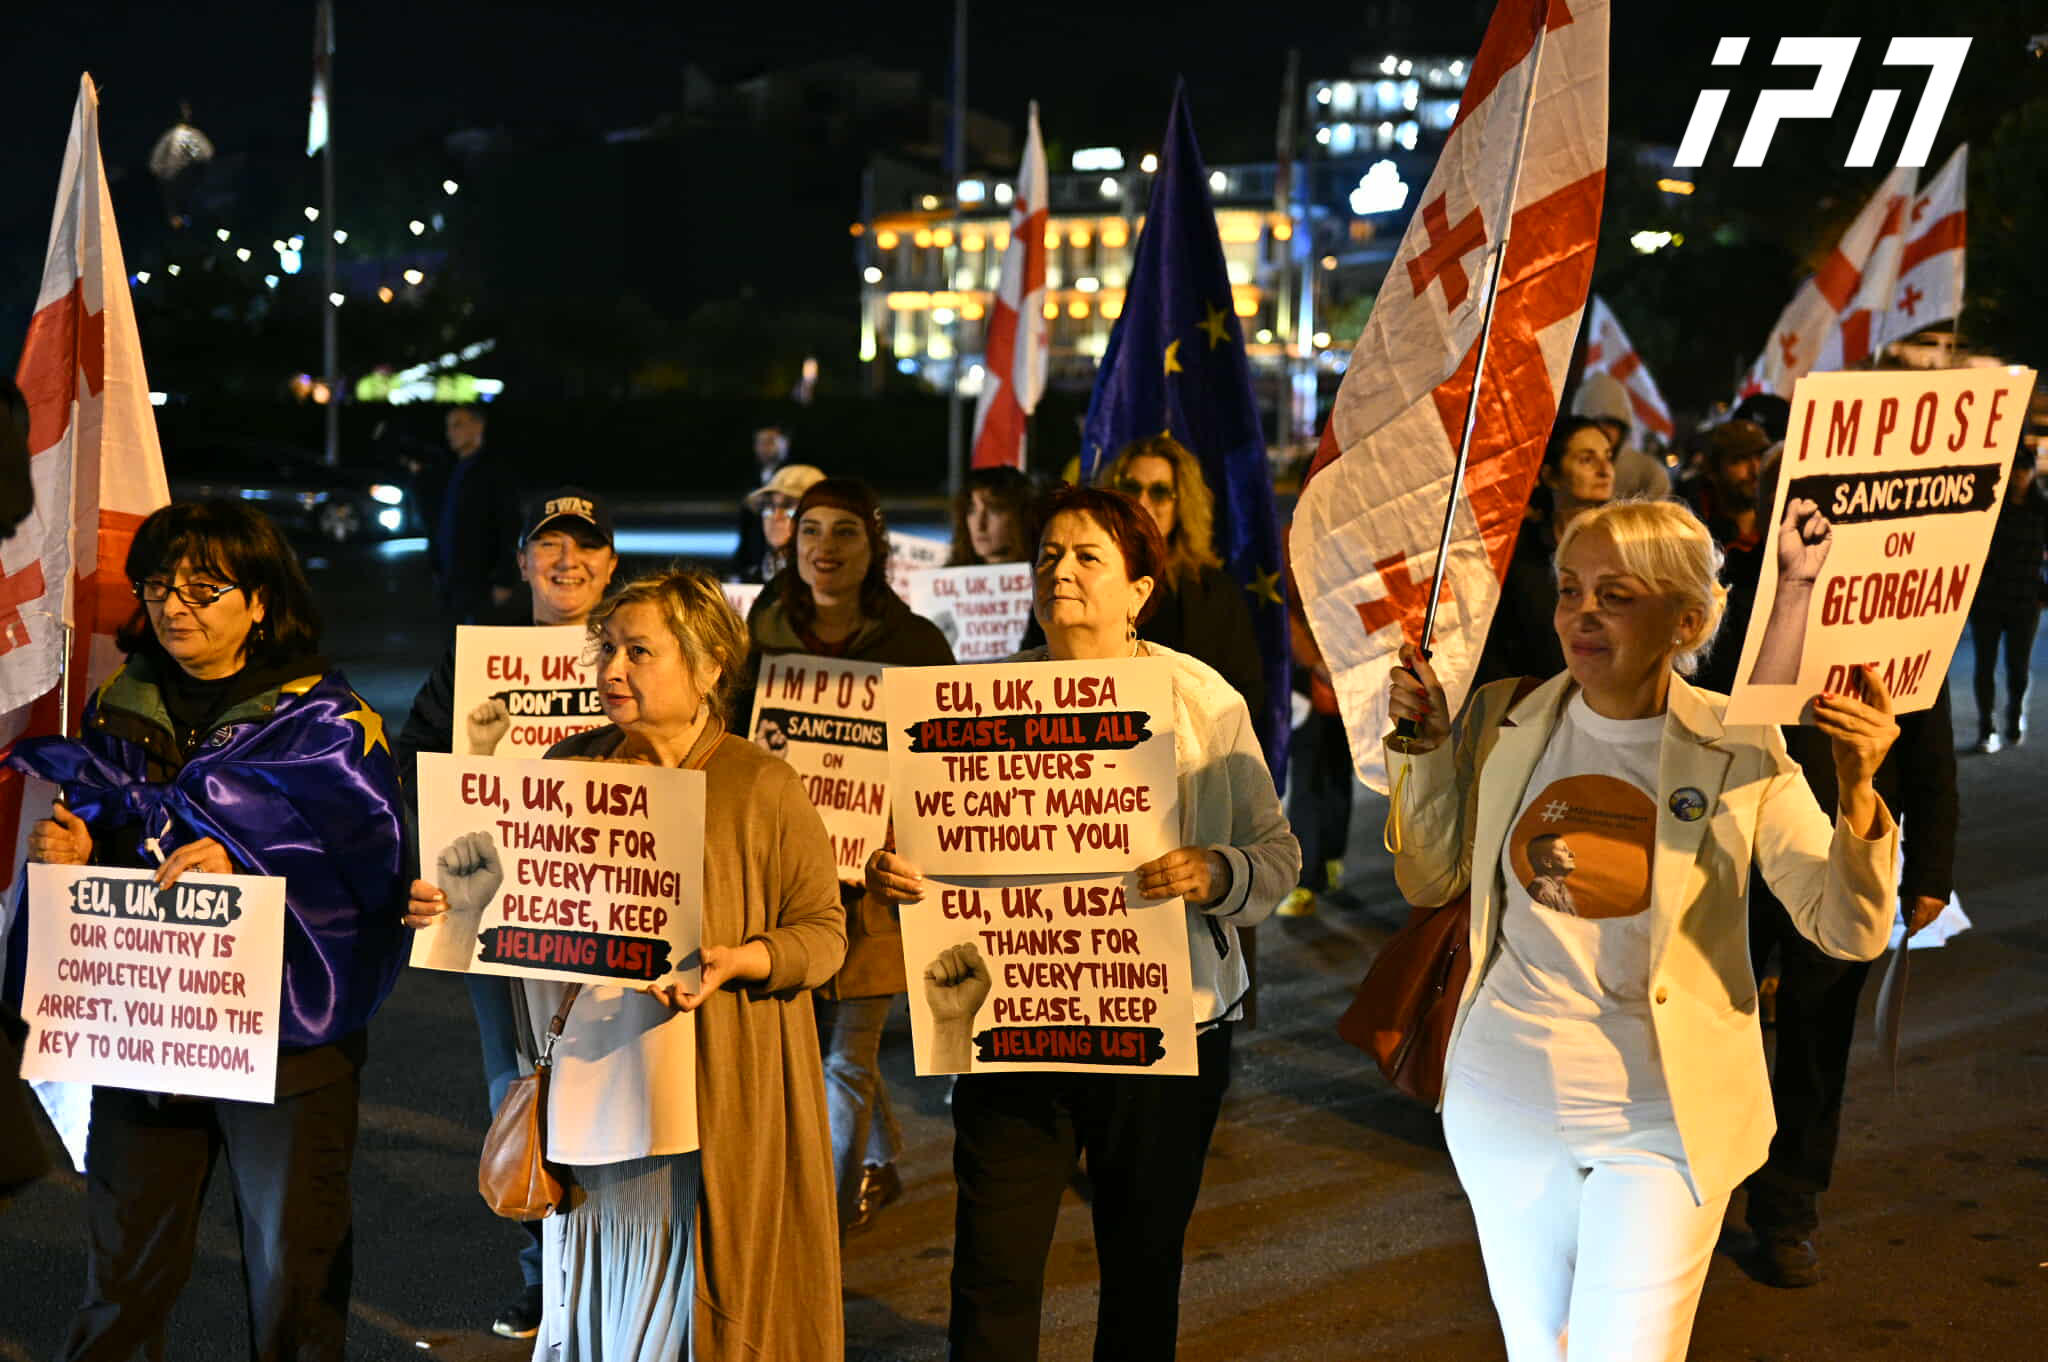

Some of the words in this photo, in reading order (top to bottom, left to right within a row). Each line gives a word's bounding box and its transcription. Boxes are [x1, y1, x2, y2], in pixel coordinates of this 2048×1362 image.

[1799, 389, 2009, 462] IMPOSE
[1831, 473, 1976, 515] SANCTIONS
[1884, 531, 1915, 558] ON
[1821, 564, 1970, 627] GEORGIAN
[487, 655, 530, 686] EU,
[542, 655, 586, 685] UK,
[765, 664, 879, 712] IMPOS
[1823, 649, 1931, 701] DRAM!
[936, 681, 981, 716] EU,
[993, 678, 1042, 714] UK,
[1054, 676, 1118, 708] USA
[787, 716, 883, 745] SANCTIONS
[920, 720, 1016, 751] PLEASE,
[1025, 716, 1086, 747] PULL
[1095, 715, 1139, 743] ALL
[822, 752, 844, 769] ON
[942, 755, 989, 783] THE
[999, 753, 1094, 781] LEVERS
[461, 773, 510, 814] EU,
[522, 775, 573, 819] UK,
[586, 780, 648, 819] USA
[801, 774, 885, 816] ORGIAN
[914, 790, 955, 818] WE
[1046, 786, 1151, 818] MANAGE
[496, 820, 600, 854] THANKS
[609, 829, 657, 861] FOR
[937, 823, 1058, 855] WITHOUT
[1067, 822, 1130, 855] YOU!
[77, 880, 117, 918] EU,
[125, 883, 166, 923] UK,
[175, 886, 229, 922] USA
[517, 859, 681, 906] EVERYTHING!
[502, 894, 599, 933] PLEASE,
[609, 902, 667, 935] KEEP
[942, 888, 991, 925] EU,
[1001, 887, 1053, 924] UK,
[1063, 886, 1127, 918] USA
[70, 923, 107, 950] OUR
[114, 926, 206, 958] COUNTRY
[212, 933, 236, 958] IS
[495, 929, 597, 966] HELPING
[607, 939, 653, 977] US!
[979, 928, 1081, 956] THANKS
[1091, 928, 1140, 956] FOR
[58, 958, 172, 993] COMPLETELY
[179, 968, 246, 998] UNDER
[1004, 962, 1168, 994] EVERYTHING!
[37, 994, 117, 1023] ARREST.
[125, 1000, 163, 1027] YOU
[171, 1005, 217, 1031] HOLD
[225, 1009, 263, 1035] THE
[993, 996, 1090, 1026] PLEASE,
[1099, 997, 1157, 1023] KEEP
[39, 1030, 79, 1058] KEY
[87, 1034, 110, 1058] TO
[117, 1036, 155, 1065] OUR
[162, 1041, 255, 1075] FREEDOM.
[993, 1031, 1092, 1057] HELPING
[1101, 1031, 1147, 1064] US!
